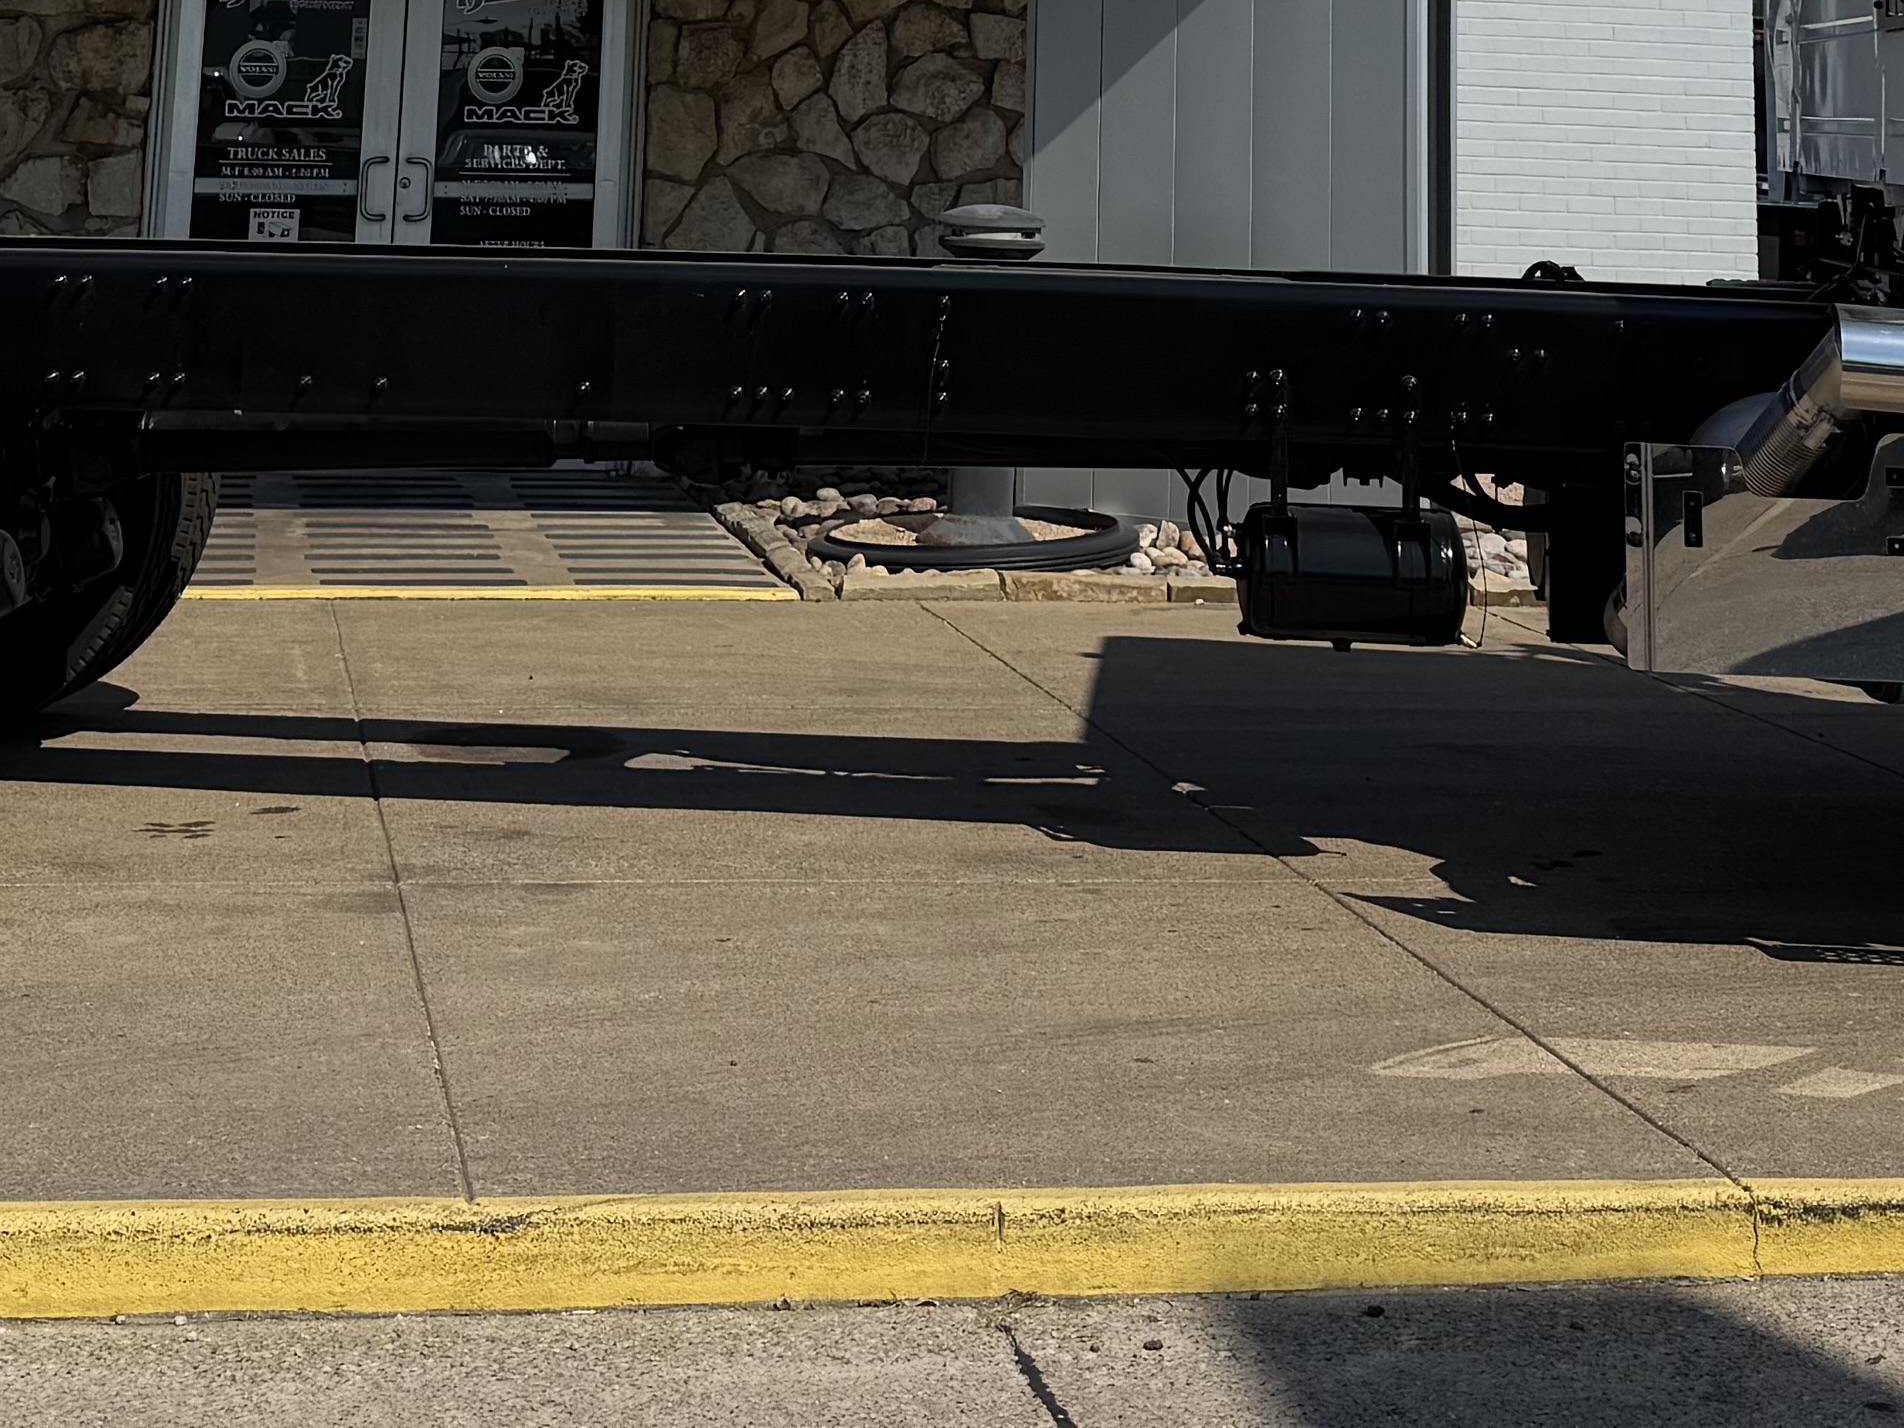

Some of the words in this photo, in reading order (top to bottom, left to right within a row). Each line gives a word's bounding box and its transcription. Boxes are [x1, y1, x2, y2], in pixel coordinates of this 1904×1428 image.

[239, 65, 278, 74] VOLVO
[477, 71, 514, 79] VOLVO
[226, 147, 278, 160] TRUCK
[279, 148, 326, 161] SALES
[250, 193, 296, 203] CLOSED
[253, 211, 295, 219] NOTICE
[459, 206, 482, 216] SUN
[488, 206, 531, 216] CLOSED
